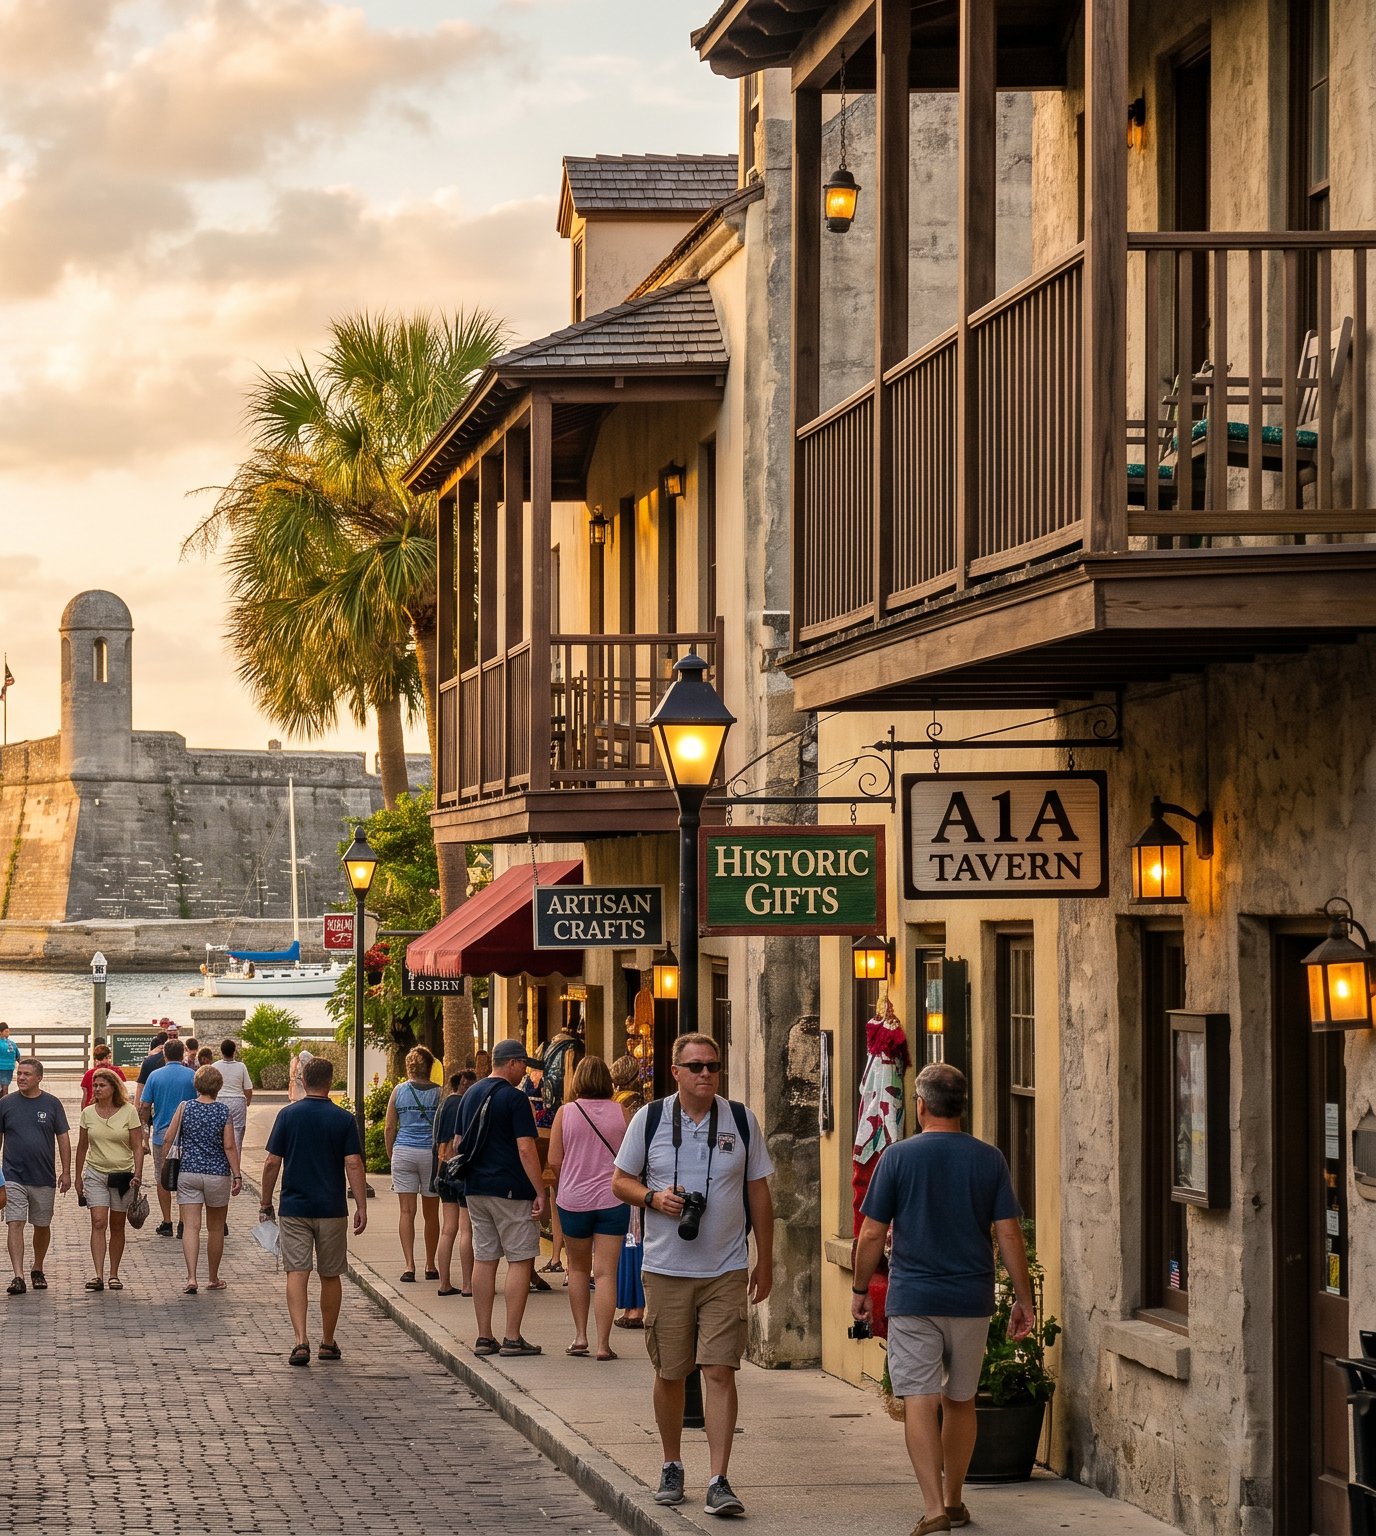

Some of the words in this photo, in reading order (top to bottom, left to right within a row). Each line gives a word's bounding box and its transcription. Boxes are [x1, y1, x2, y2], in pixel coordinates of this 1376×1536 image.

[930, 789, 1080, 844] A1A
[714, 845, 870, 878] HISTORIC
[928, 851, 1084, 882] TAVERN
[546, 893, 653, 916] ARTISAN
[744, 882, 840, 916] GIFTS
[553, 919, 647, 941] CRAFTS
